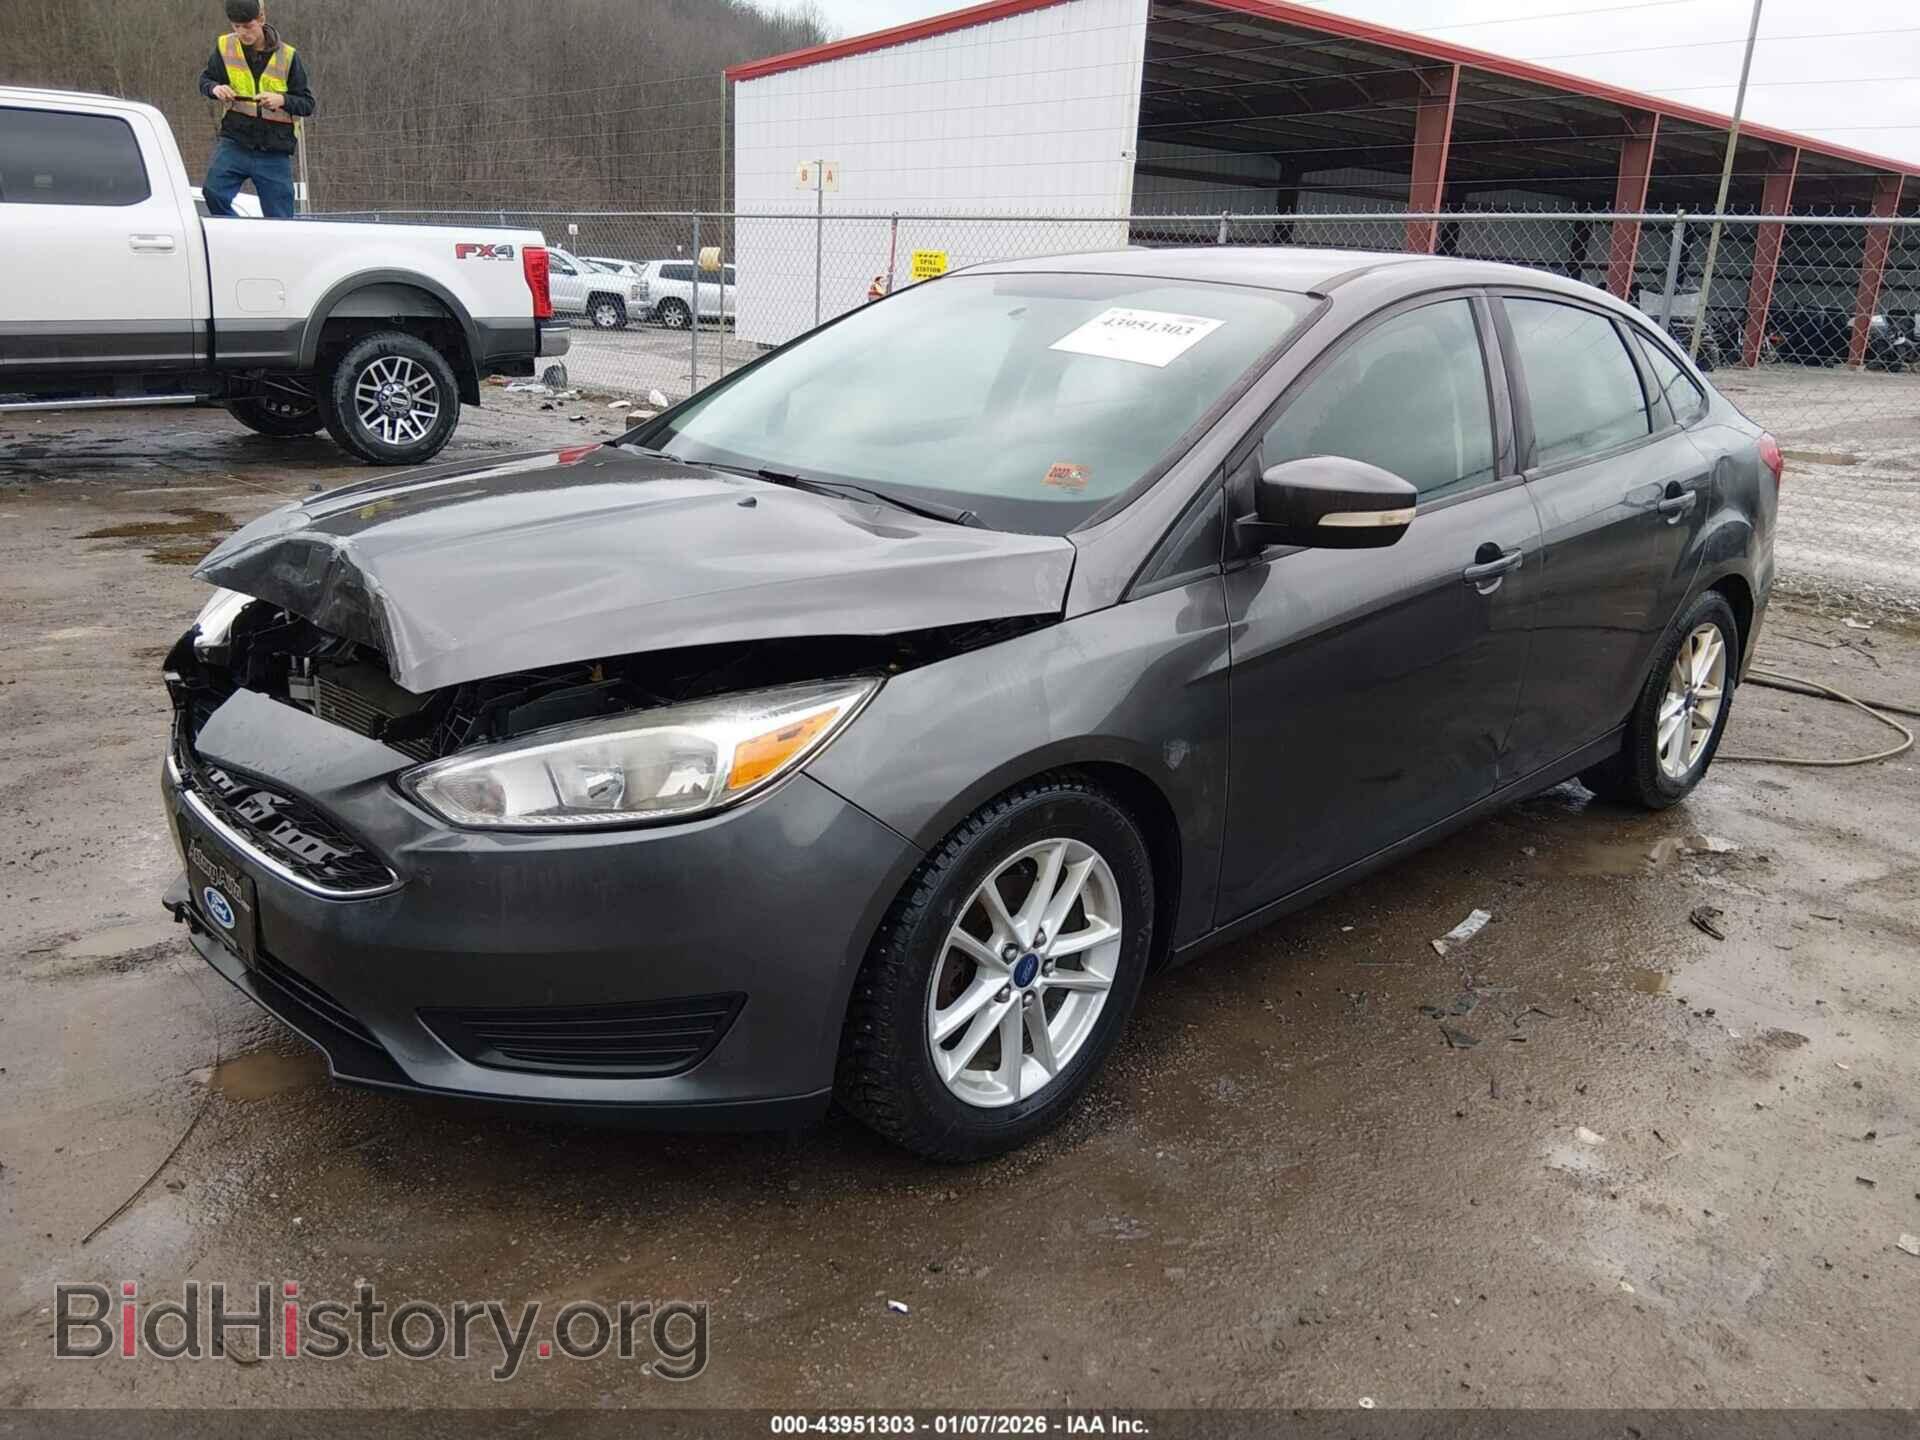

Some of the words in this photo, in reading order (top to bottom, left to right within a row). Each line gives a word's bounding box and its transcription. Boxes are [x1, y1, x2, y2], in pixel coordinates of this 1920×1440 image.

[801, 168, 808, 182] B
[826, 169, 833, 183] A
[456, 243, 514, 259] FX4
